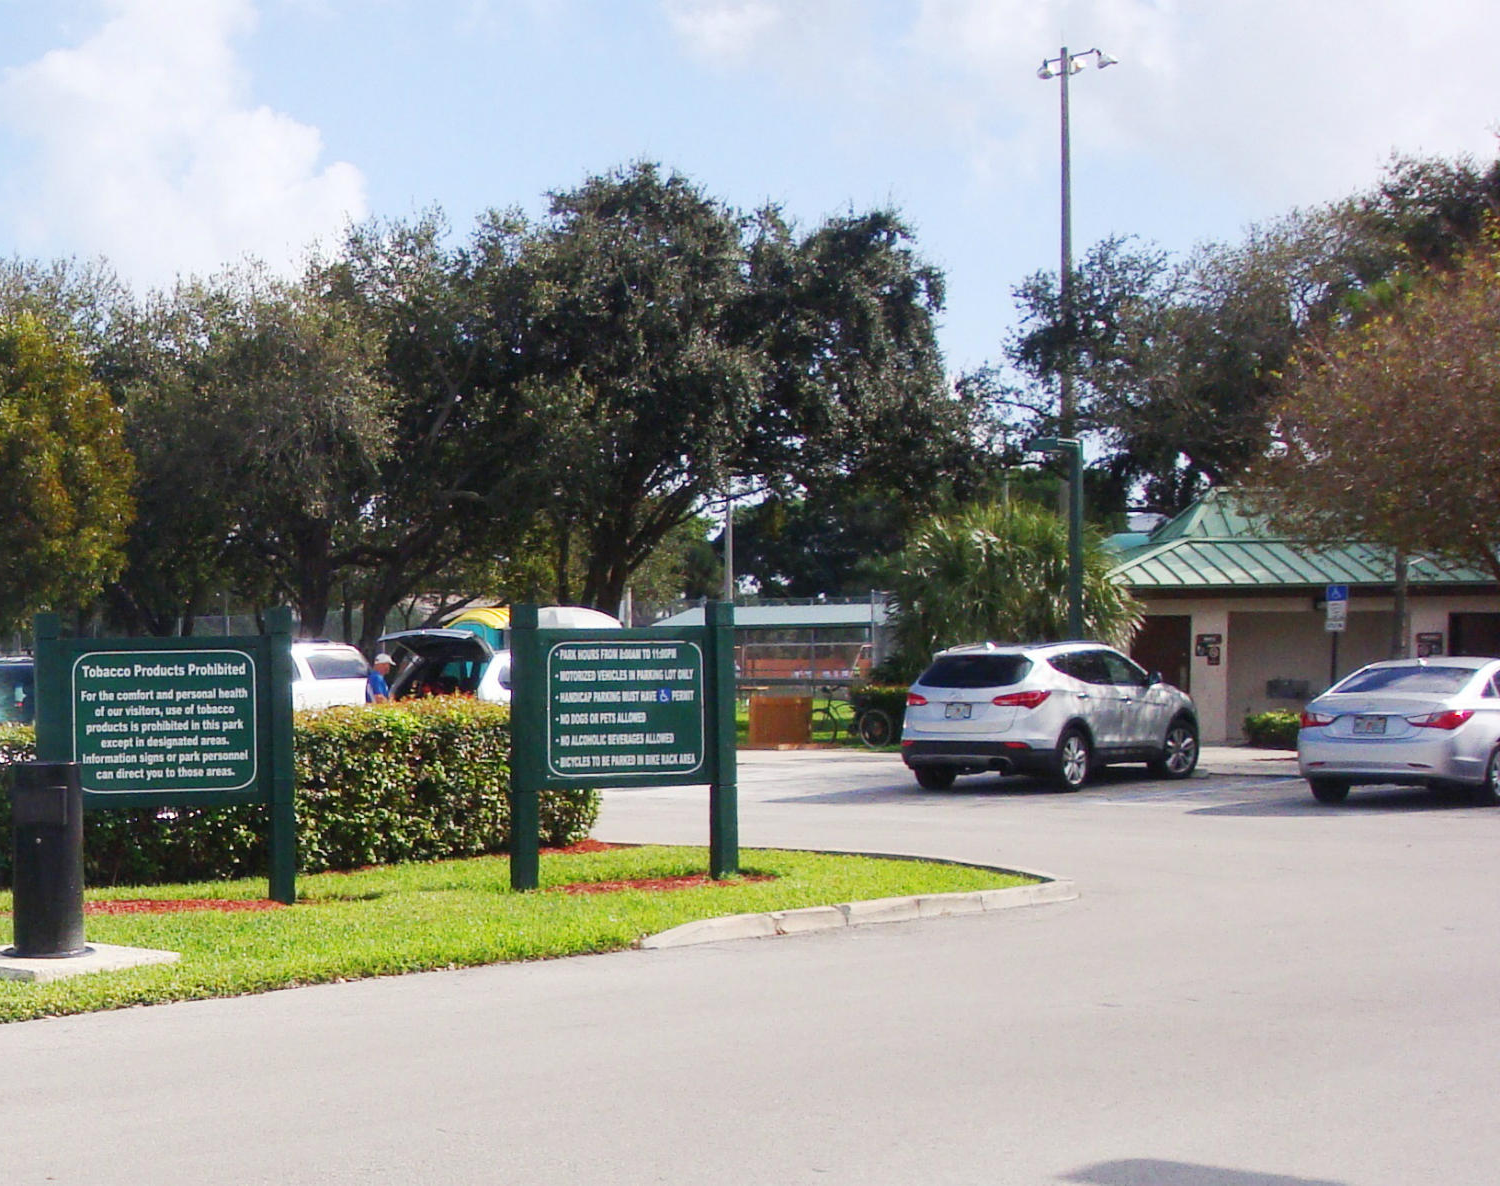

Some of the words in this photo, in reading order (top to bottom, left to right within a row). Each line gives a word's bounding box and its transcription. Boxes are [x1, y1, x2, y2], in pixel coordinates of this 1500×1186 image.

[559, 648, 577, 660] PARK
[577, 648, 600, 660] HOURS
[600, 648, 619, 660] FROM
[642, 648, 651, 659] TO
[82, 664, 131, 678] Tobacco
[133, 663, 185, 677] Products
[188, 662, 246, 676] Prohibited
[559, 670, 597, 682] MOTORIZED
[597, 669, 628, 681] VEHICLES
[628, 669, 636, 681] IN
[636, 669, 664, 681] PARKING
[664, 669, 677, 680] LOT
[677, 668, 694, 680] ONLY
[81, 690, 97, 702] For
[99, 690, 114, 701] the
[116, 688, 154, 701] comfort
[156, 688, 174, 700] and
[175, 687, 216, 702] personal
[218, 686, 248, 699] health
[559, 691, 593, 703] HANDICAP
[593, 691, 621, 702] PARKING
[621, 691, 640, 702] MUST
[640, 690, 657, 702] HAVE
[671, 690, 695, 701] PERMIT
[94, 705, 105, 717] of
[107, 708, 123, 717] our
[125, 705, 164, 718] visitors,
[165, 705, 183, 716] use
[185, 703, 195, 715] of
[197, 703, 235, 715] tobacco
[560, 713, 570, 725] NO
[570, 713, 589, 725] DOGS
[589, 713, 600, 724] OR
[600, 713, 617, 724] PETS
[617, 711, 647, 723] ALLOWED
[86, 721, 128, 736] products
[130, 721, 139, 732] is
[141, 719, 189, 734] prohibited
[191, 719, 200, 731] in
[202, 719, 220, 731] this
[222, 718, 244, 732] park
[101, 737, 133, 750] except
[135, 736, 145, 747] in
[147, 734, 199, 749] designated
[200, 736, 230, 746] areas.
[560, 735, 570, 747] NO
[571, 734, 607, 746] ALCOHOLIC
[607, 733, 645, 745] BEVERAGES
[645, 732, 675, 744] ALLOWED
[82, 753, 137, 765] Information
[139, 751, 164, 765] signs
[166, 753, 177, 762] or
[179, 750, 200, 764] park
[202, 749, 249, 764] personnel
[559, 756, 591, 768] BICYCLES
[591, 756, 601, 767] TO
[601, 755, 612, 767] BE
[612, 754, 636, 766] PARKED
[636, 754, 645, 766] IN
[645, 754, 661, 766] BIKE
[661, 754, 679, 765] RACK
[679, 753, 696, 764] AREA
[96, 770, 114, 780] can
[115, 767, 145, 779] direct
[146, 768, 164, 781] you
[165, 767, 176, 778] to
[177, 766, 204, 777] those
[206, 767, 236, 777] areas.
